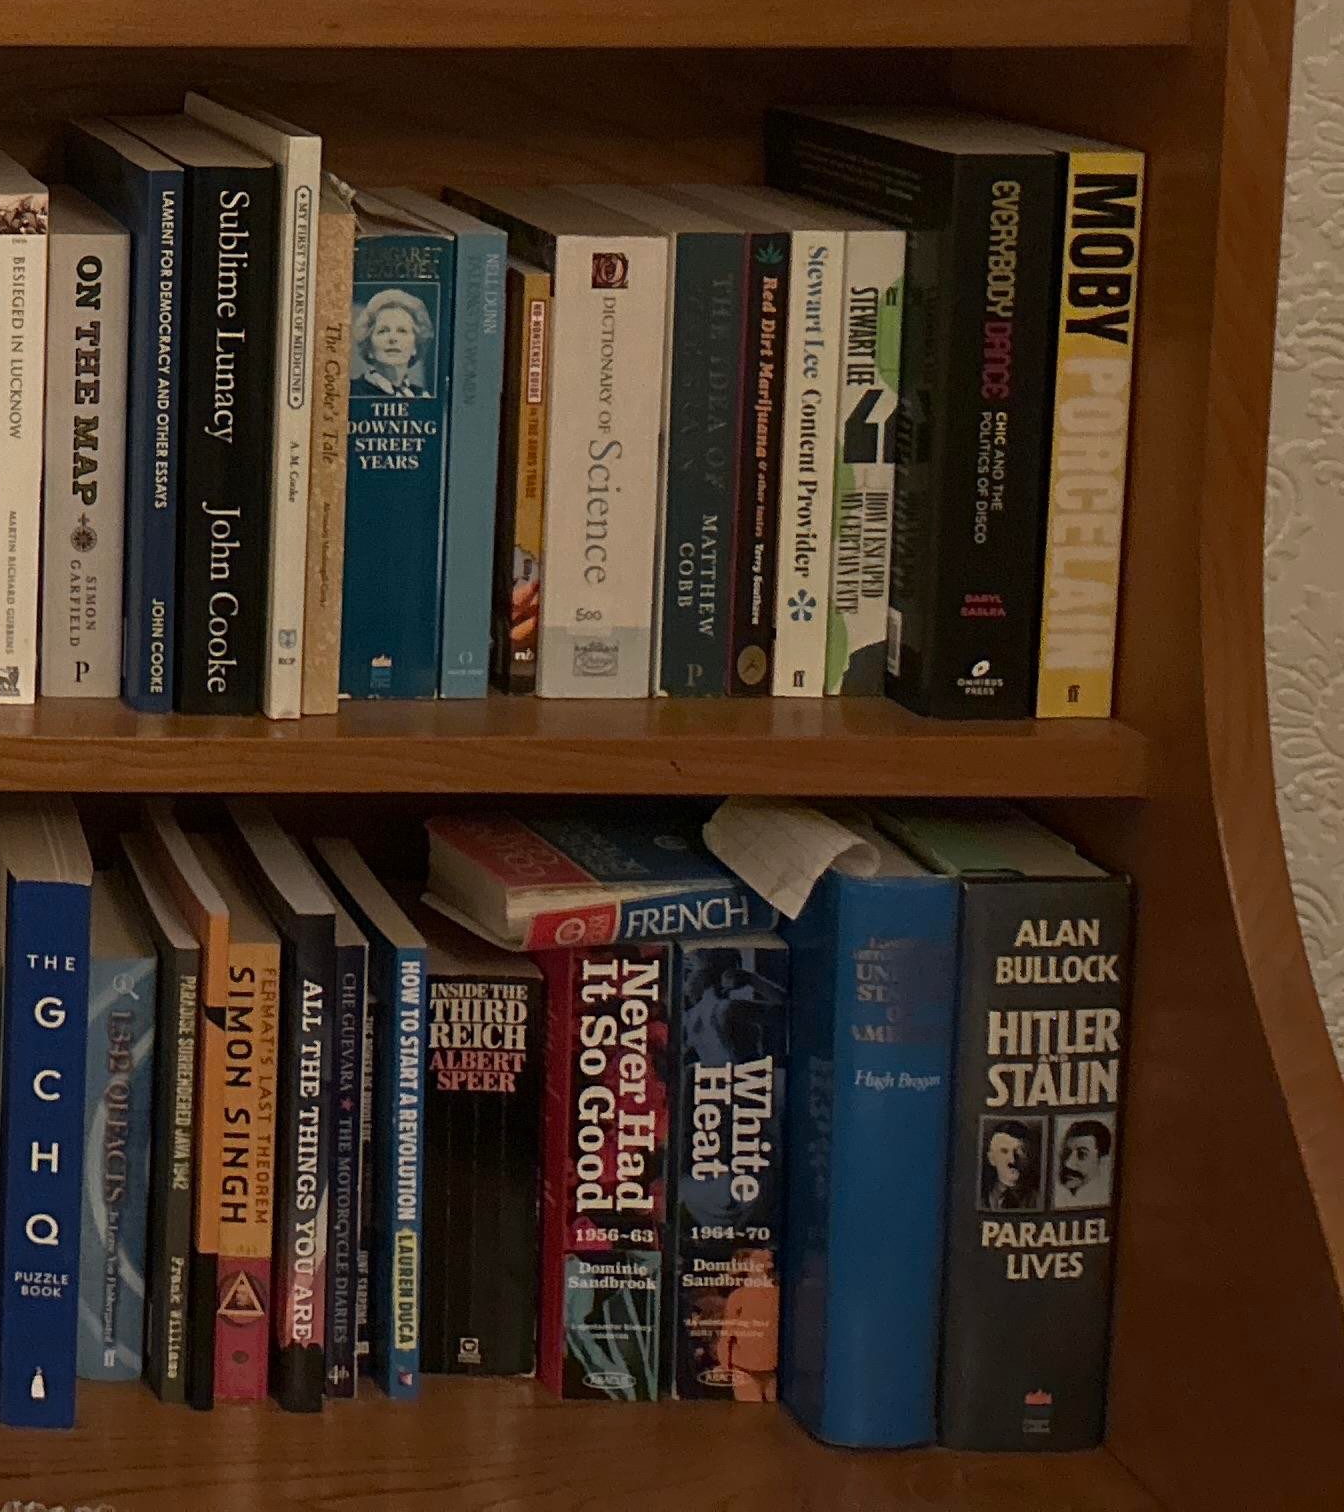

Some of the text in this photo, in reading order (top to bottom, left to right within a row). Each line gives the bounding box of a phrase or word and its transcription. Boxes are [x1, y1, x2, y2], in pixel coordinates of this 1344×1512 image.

[1066, 174, 1139, 345] MOBY
[204, 190, 250, 444] Sublime Lunacy
[71, 256, 103, 506] ON THE MAP
[583, 439, 622, 586] Science
[626, 896, 748, 937] FRENCH
[1015, 918, 1100, 947] ALAN
[28, 954, 75, 970] THE
[995, 954, 1118, 984] BULLOCK
[430, 1001, 528, 1024] THIRD
[430, 1026, 527, 1048] REICH
[986, 1008, 1121, 1056] HITLER
[431, 1050, 526, 1071] ALBERT
[221, 966, 254, 1225] SIMON SINGH
[436, 1072, 516, 1091] SPEER
[986, 1061, 1117, 1106] STALIN
[693, 1062, 731, 1182] Heat
[731, 1056, 772, 1202] White
[980, 1219, 1110, 1246] PARALLEL
[15, 1272, 68, 1284] PUZZLE
[1008, 1252, 1084, 1278] LIVES
[20, 1284, 62, 1298] BOOK
